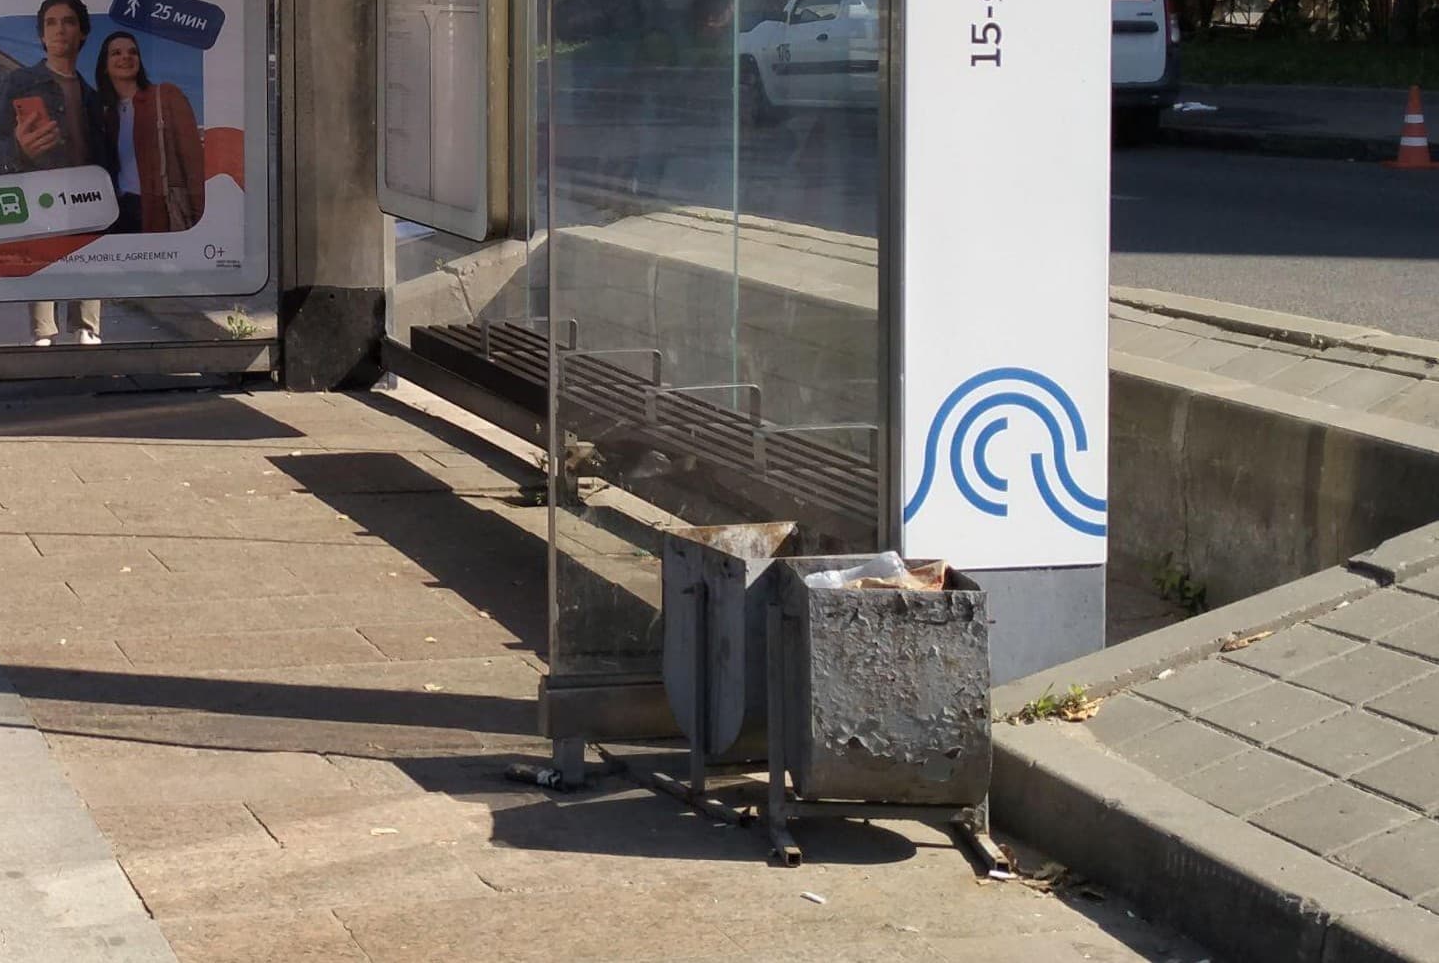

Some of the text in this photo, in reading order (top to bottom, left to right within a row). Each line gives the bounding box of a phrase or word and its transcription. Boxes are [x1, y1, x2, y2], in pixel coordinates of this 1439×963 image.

[151, 2, 208, 31] 25 мин
[58, 191, 101, 205] 1 мин
[203, 244, 226, 260] 0+
